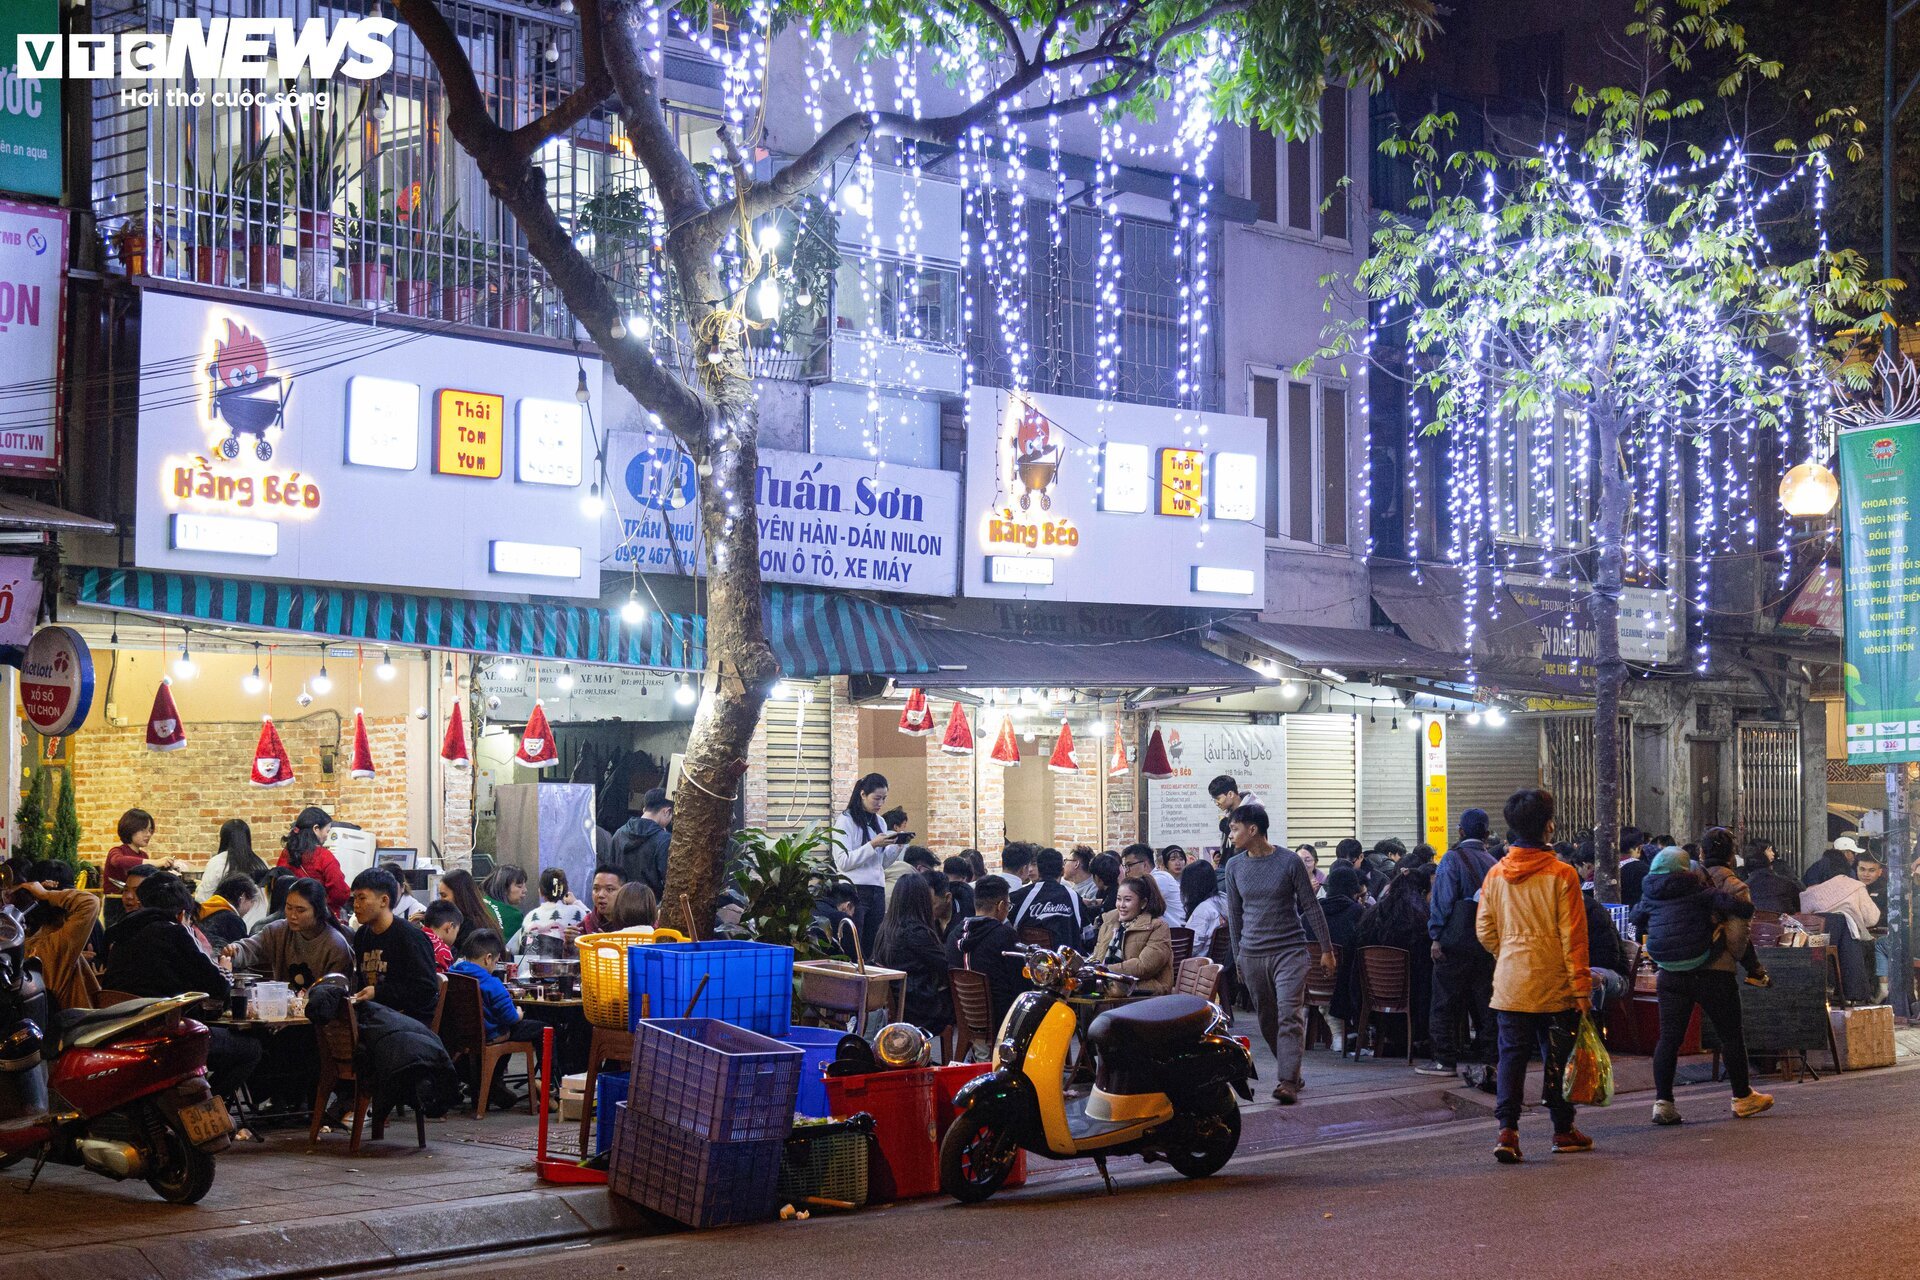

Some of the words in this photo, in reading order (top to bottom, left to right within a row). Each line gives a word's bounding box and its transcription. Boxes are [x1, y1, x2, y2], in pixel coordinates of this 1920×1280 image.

[13, 144, 24, 156] an
[26, 146, 48, 161] aqua
[455, 401, 490, 420] Thái
[1171, 455, 1194, 471] Thái
[174, 456, 254, 507] Hằng
[263, 472, 321, 509] Béo
[755, 462, 842, 513] Tuấn
[854, 476, 924, 522] Sơn
[623, 514, 661, 541] TRẦN
[665, 521, 694, 542] PHÚ
[800, 518, 838, 545] HÀN
[848, 523, 886, 550] DÁN
[891, 531, 941, 556] NILON
[1042, 519, 1079, 548] Béo
[650, 547, 671, 565] 467
[792, 547, 805, 574] Ô
[811, 549, 839, 579] TÔ,
[844, 557, 868, 579] XE
[873, 556, 913, 582] MÁY
[580, 674, 592, 683] XE
[594, 672, 614, 683] MÁY
[42, 689, 54, 702] SỐ
[37, 704, 60, 718] CHỌN
